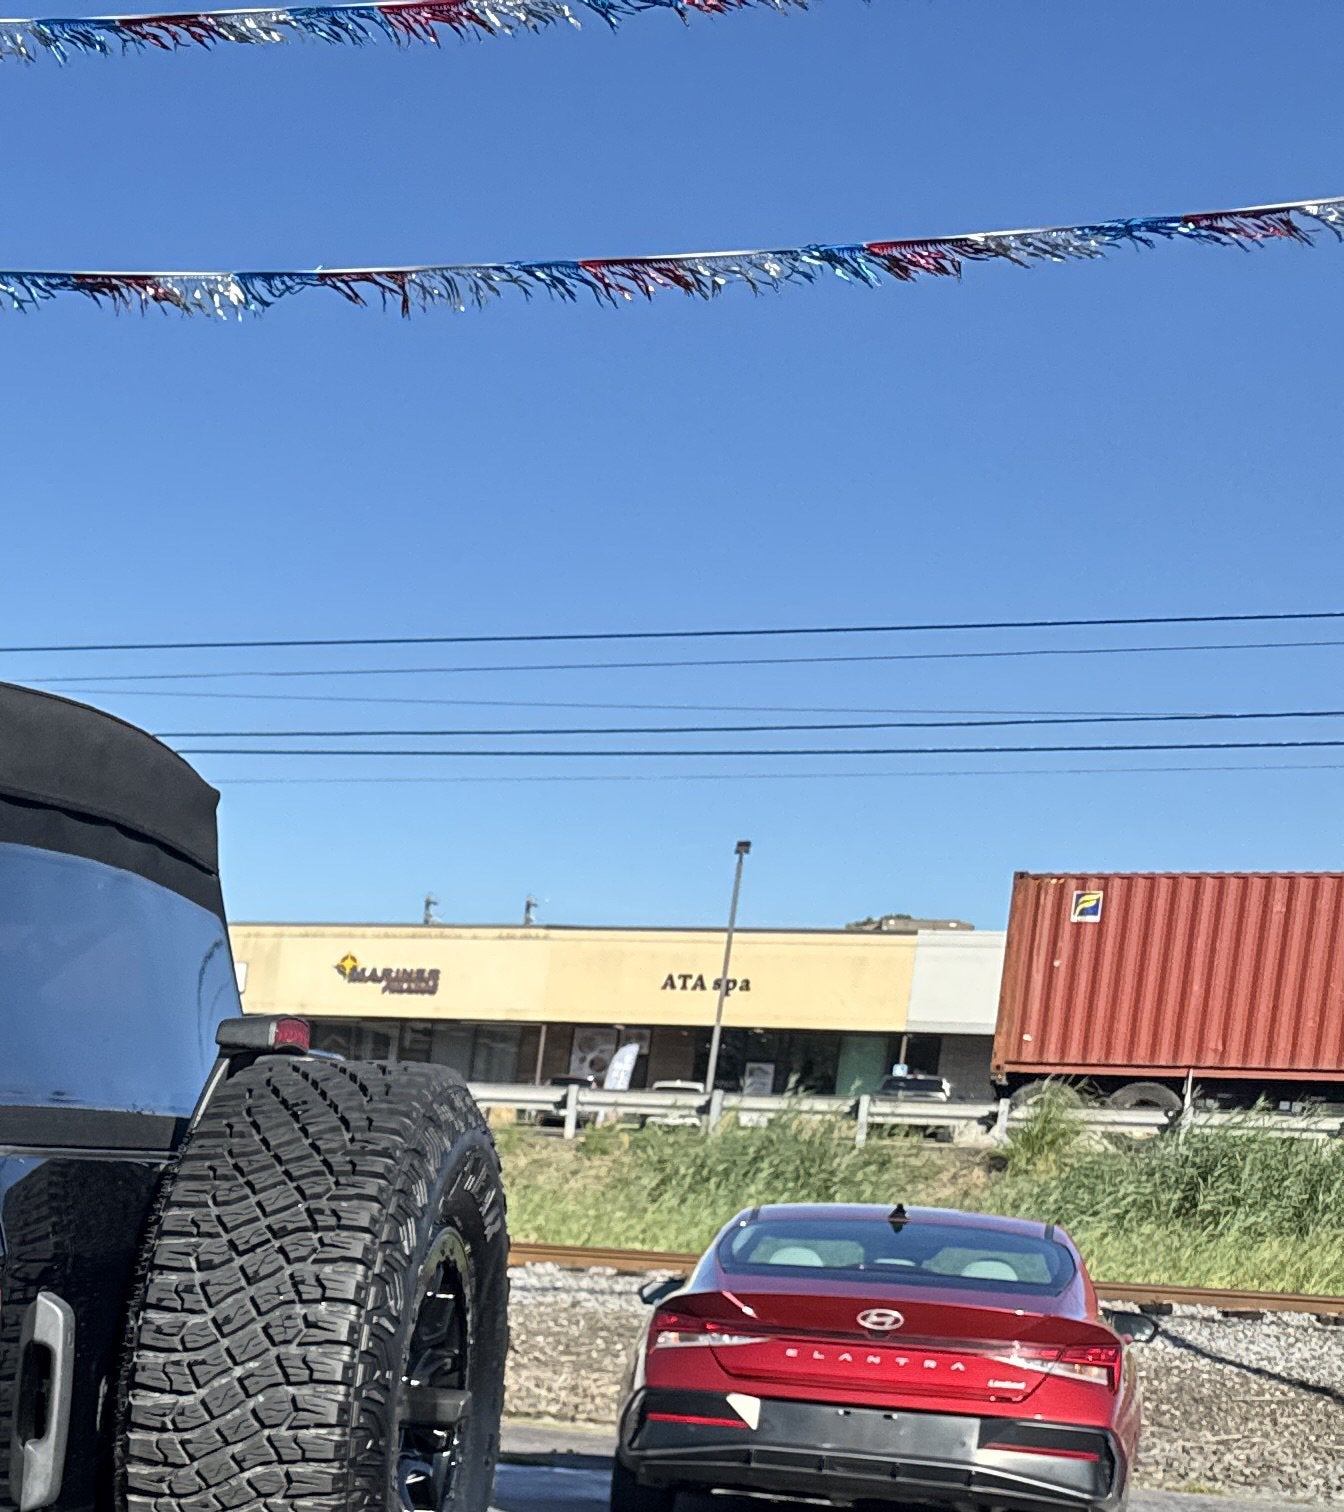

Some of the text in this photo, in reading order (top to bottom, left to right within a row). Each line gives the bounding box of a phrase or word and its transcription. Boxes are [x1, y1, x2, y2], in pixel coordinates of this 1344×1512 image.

[347, 967, 440, 983] MARINER
[661, 973, 751, 997] ATA spa
[786, 1348, 965, 1372] ELANTRA
